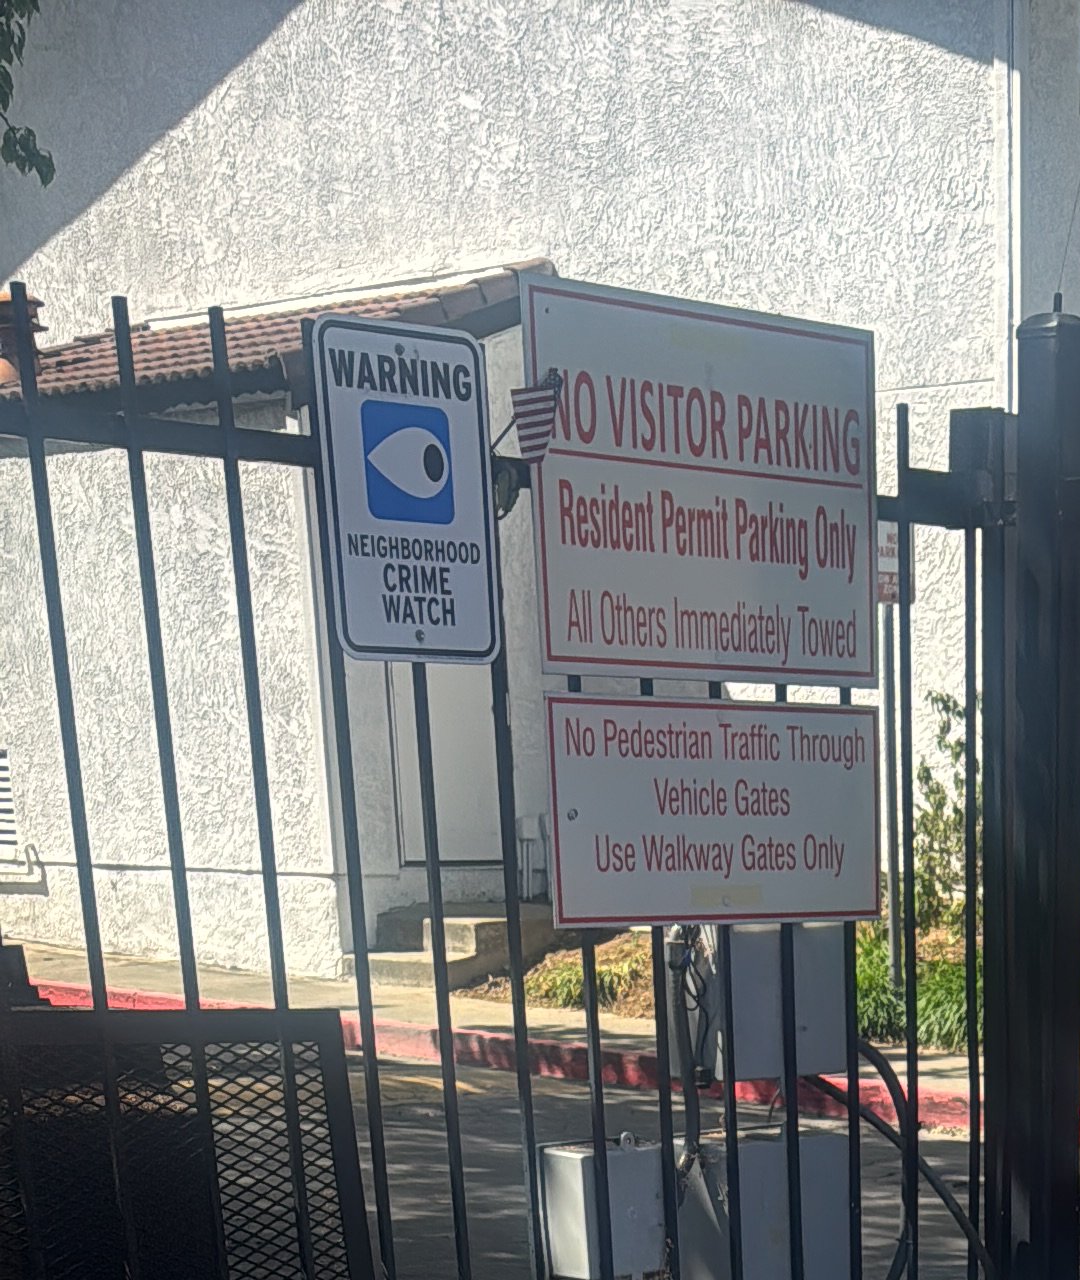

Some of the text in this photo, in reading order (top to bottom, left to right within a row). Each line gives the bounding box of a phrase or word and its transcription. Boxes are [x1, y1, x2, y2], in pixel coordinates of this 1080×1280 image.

[328, 347, 472, 402] WARNING
[551, 368, 861, 476] NO VISITOR PARKING
[347, 533, 481, 565] NEIGHBORHOOD
[558, 478, 857, 584] Resident Permit Parking Only
[383, 563, 452, 595] CRIME
[382, 594, 456, 626] WATCH
[567, 588, 857, 666] All Others Immediately Towed
[565, 717, 865, 771] No Pedestrian Traffic Through
[654, 777, 790, 816] Vehicle Gates
[595, 833, 845, 879] Use Walkway Gates Only
